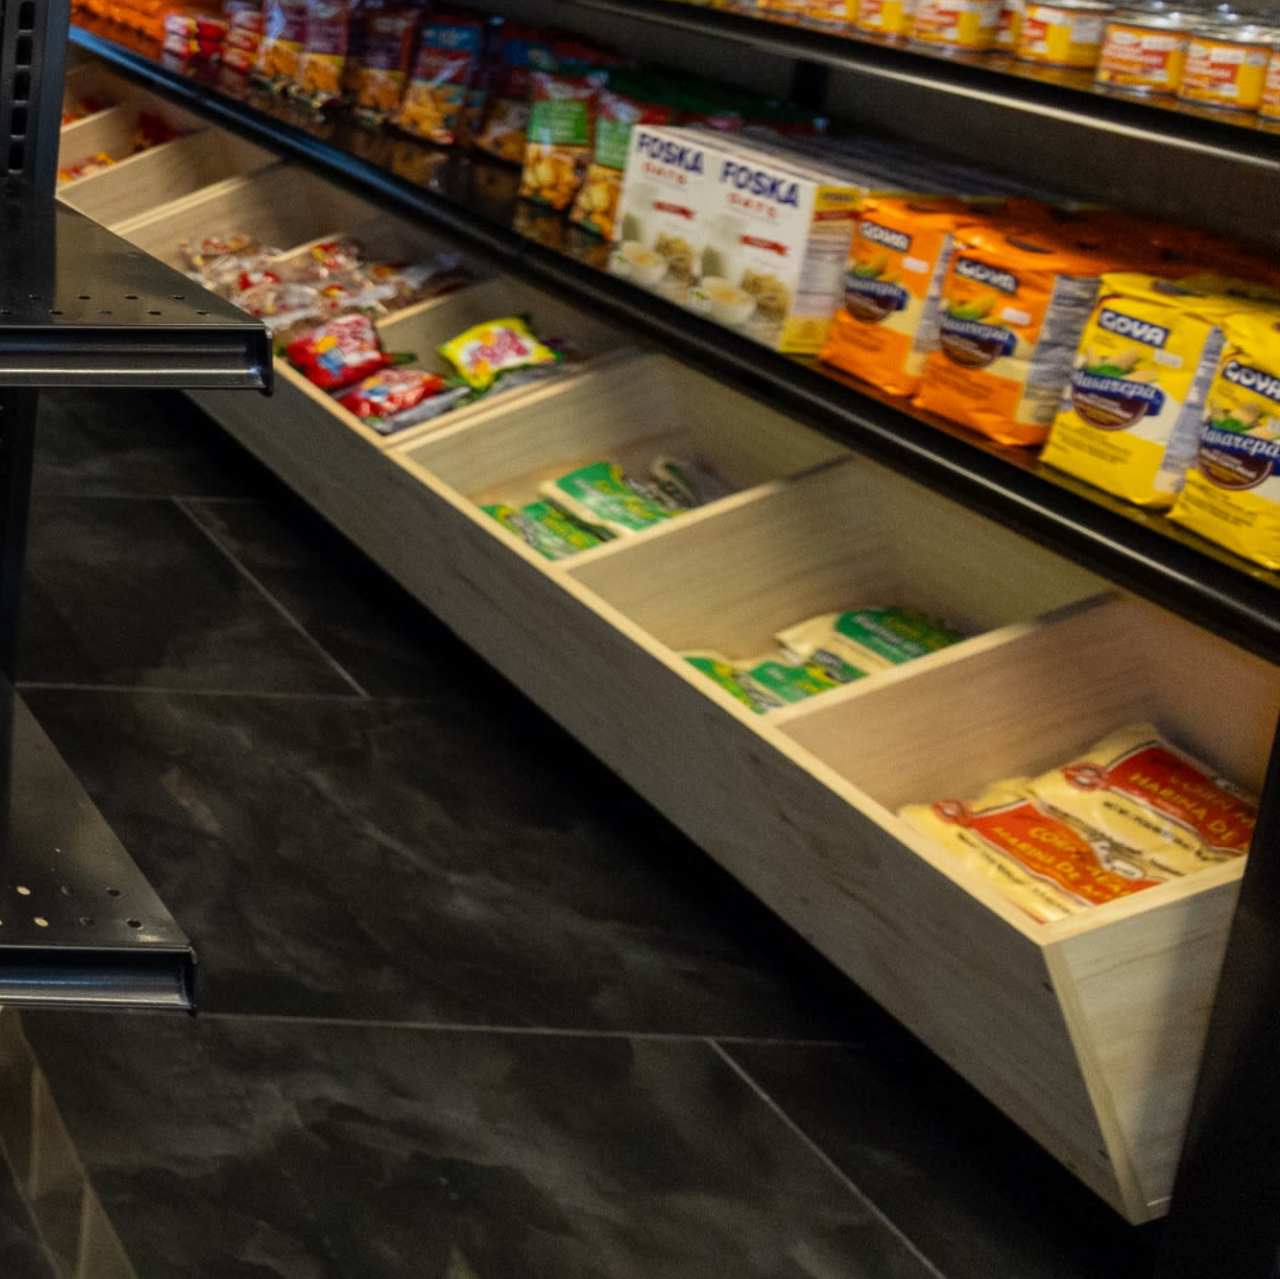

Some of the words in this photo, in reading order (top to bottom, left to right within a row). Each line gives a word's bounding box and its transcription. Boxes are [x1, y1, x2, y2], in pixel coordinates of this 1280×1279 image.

[638, 133, 704, 174] FOSKA
[720, 160, 799, 207] FOSKA
[1100, 312, 1166, 345] GOYA
